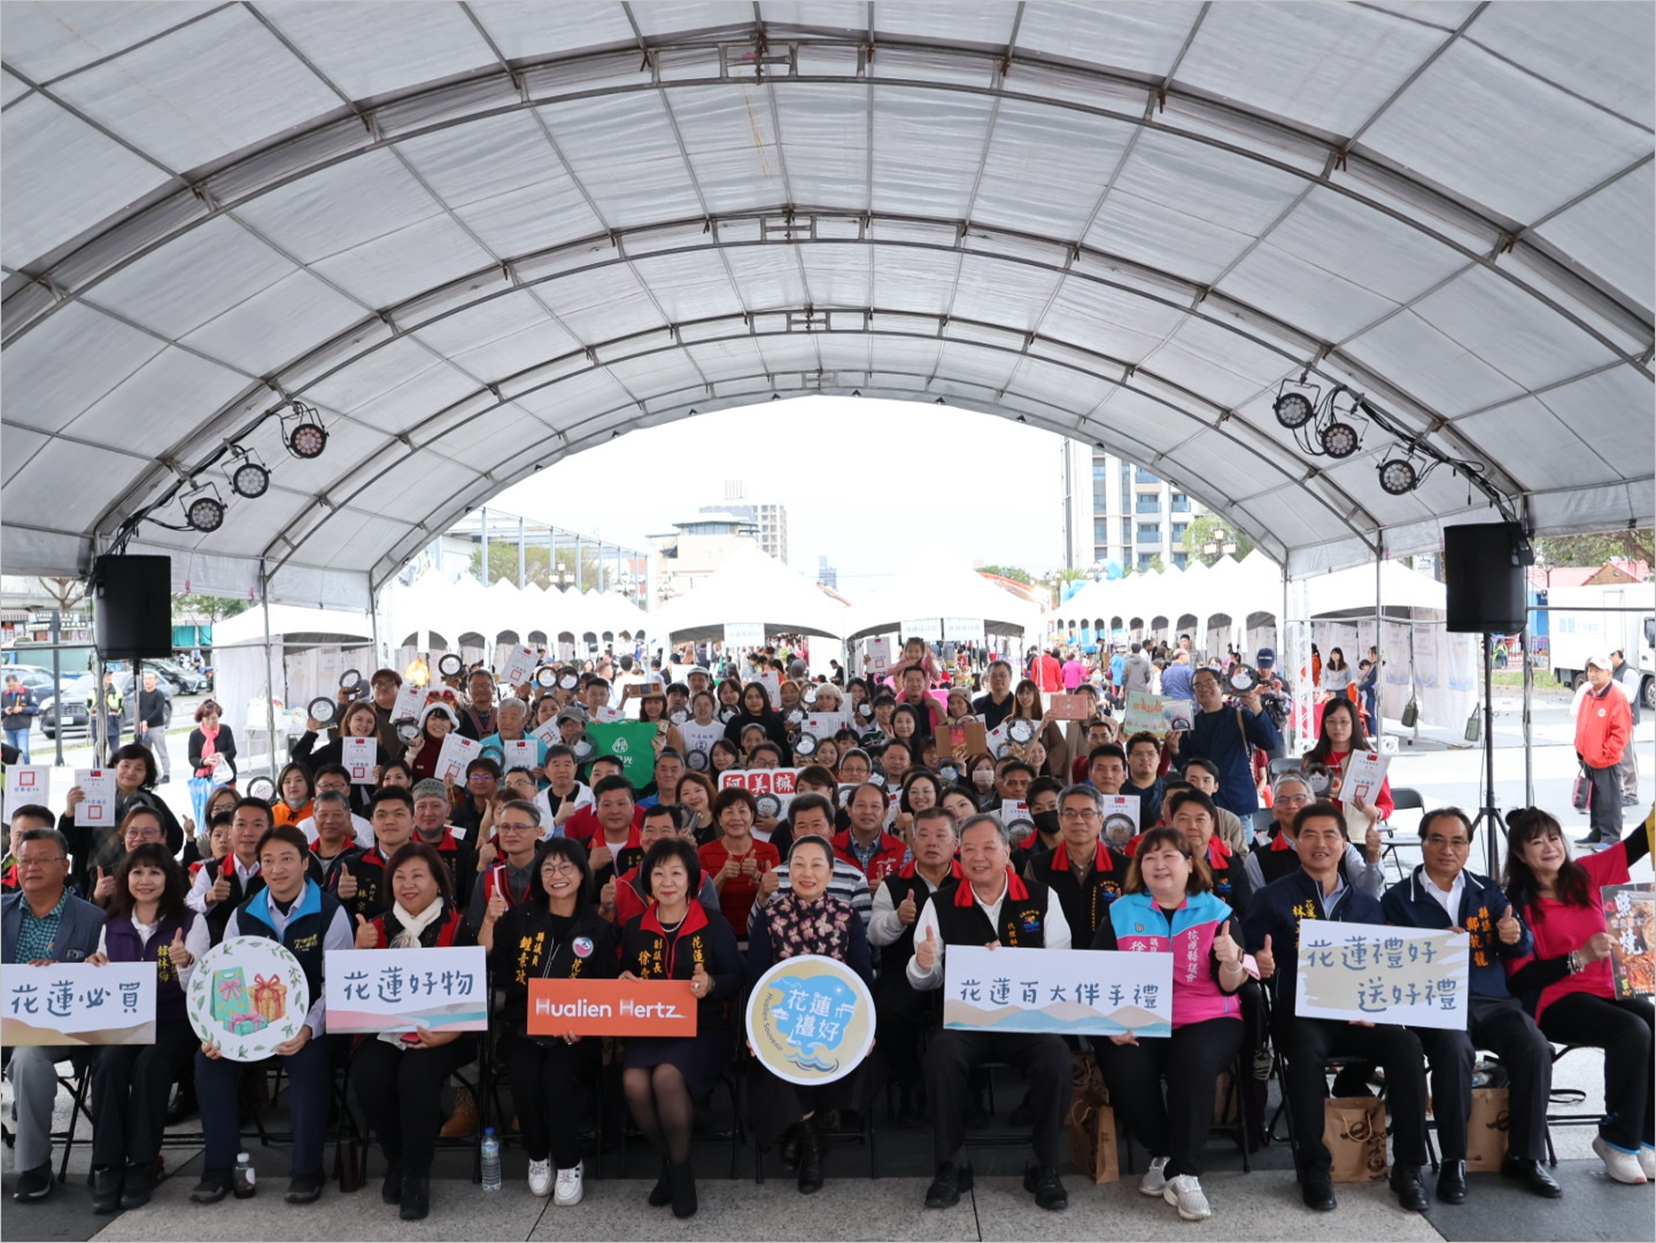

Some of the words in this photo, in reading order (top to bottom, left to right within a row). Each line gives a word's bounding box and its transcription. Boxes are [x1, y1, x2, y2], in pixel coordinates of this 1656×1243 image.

[1185, 929, 1199, 983] 花蓮縣議會
[1307, 936, 1438, 971] 花蓮禮好
[11, 980, 141, 1017] 花蓮必買
[343, 966, 473, 1003] 花蓮好物
[960, 978, 1159, 1009] 花蓮百大伴手禮
[1358, 976, 1457, 1013] 送好禮
[535, 997, 612, 1018] Hualien
[619, 997, 688, 1018] Hertz
[788, 989, 832, 1017] 花蓮
[794, 1014, 840, 1042] 禮好
